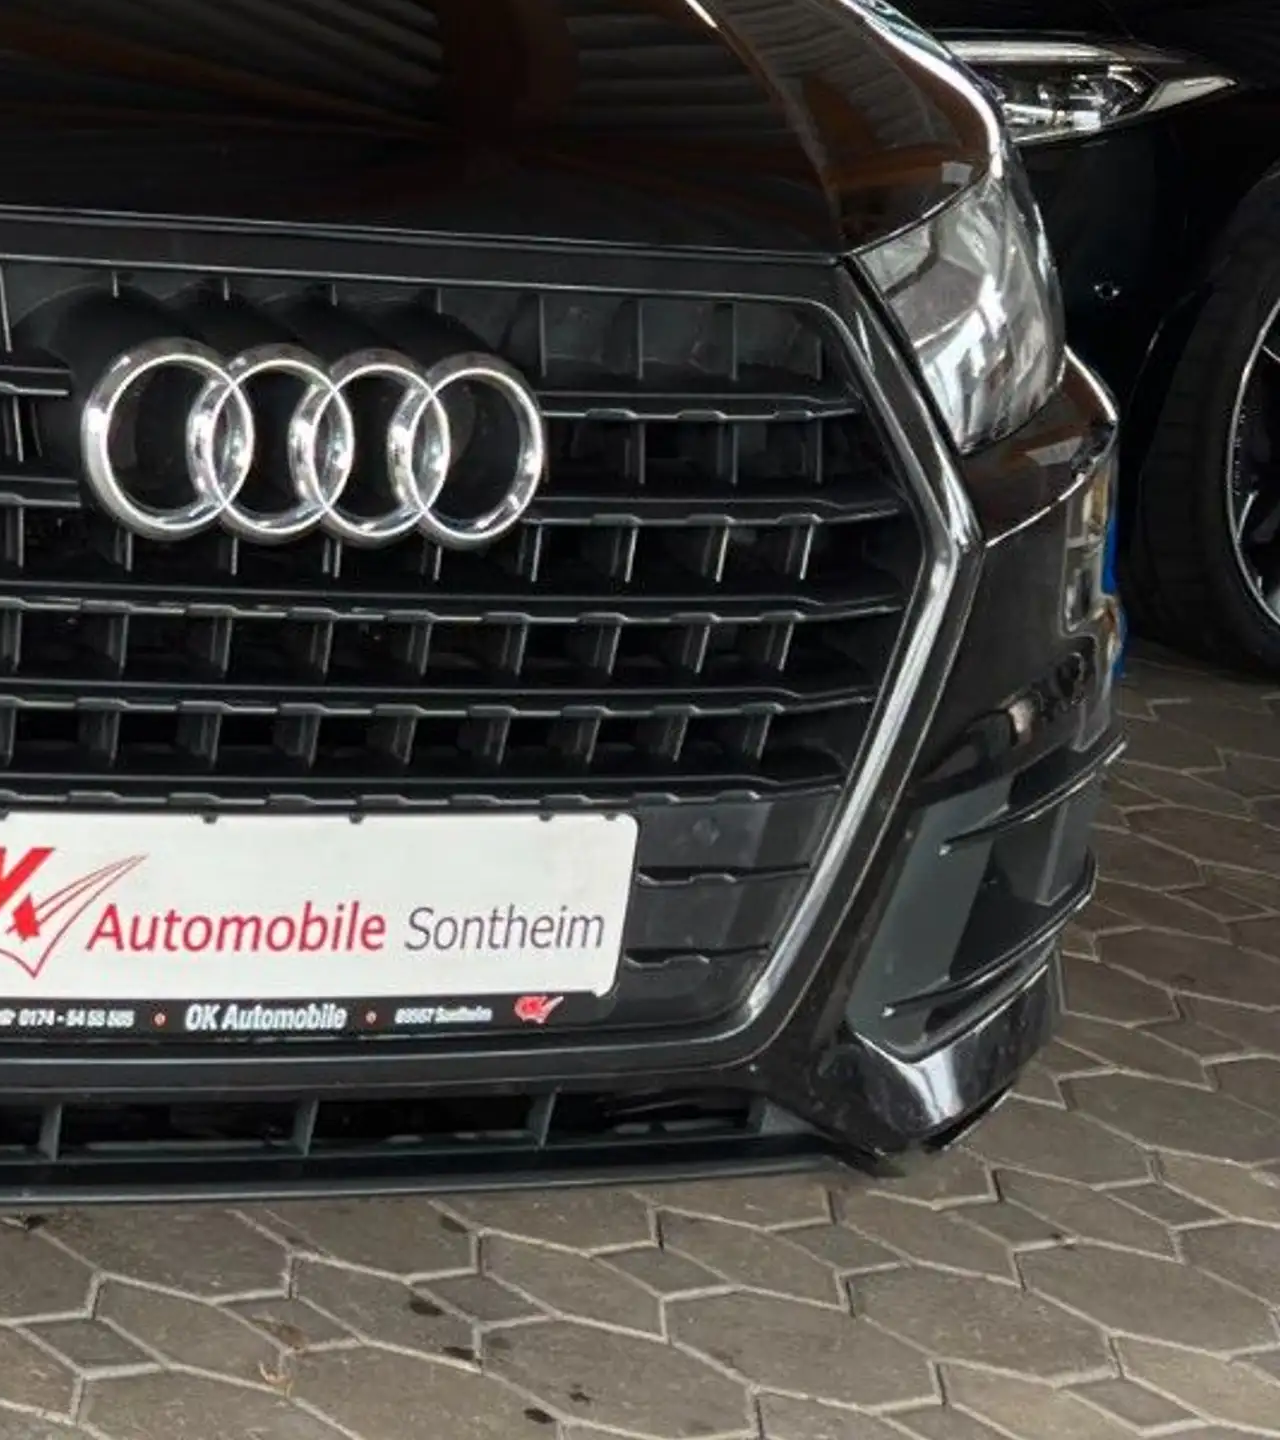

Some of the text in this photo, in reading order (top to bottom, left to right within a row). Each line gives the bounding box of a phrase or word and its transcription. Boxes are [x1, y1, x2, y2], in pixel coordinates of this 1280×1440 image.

[86, 902, 386, 952] Automobile
[404, 903, 606, 951] Sontheim
[185, 1003, 220, 1031] OK
[221, 1003, 348, 1031] Automobile
